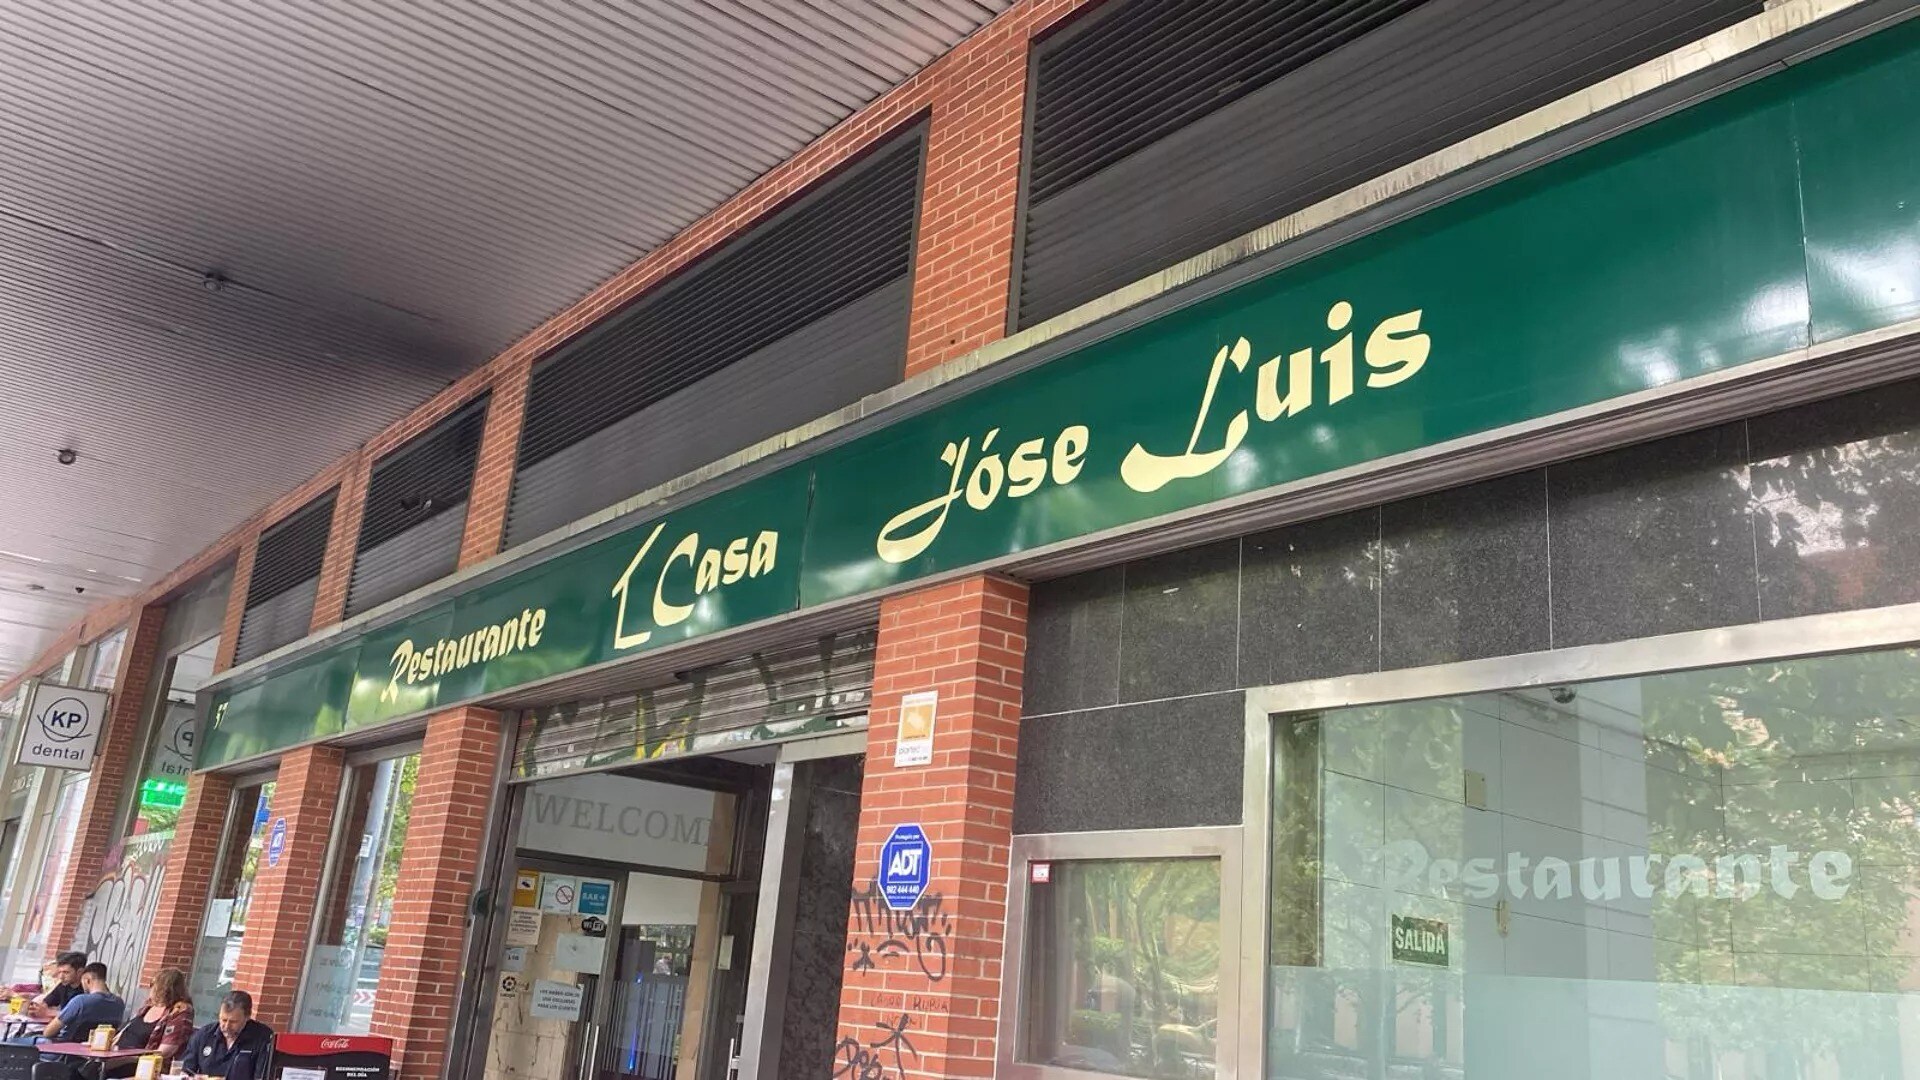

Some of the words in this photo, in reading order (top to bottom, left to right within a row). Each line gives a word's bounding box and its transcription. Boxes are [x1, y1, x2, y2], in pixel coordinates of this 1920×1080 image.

[380, 607, 546, 704] Restaurante
[652, 531, 779, 627] Casa
[876, 425, 1090, 563] Jóse
[1120, 301, 1432, 493] Luis
[50, 710, 83, 729] KP
[32, 743, 85, 761] dental
[532, 790, 713, 846] WELCOM
[888, 848, 922, 877] ADT
[1378, 838, 1856, 902] Restaurante
[1395, 926, 1446, 955] SALIDA
